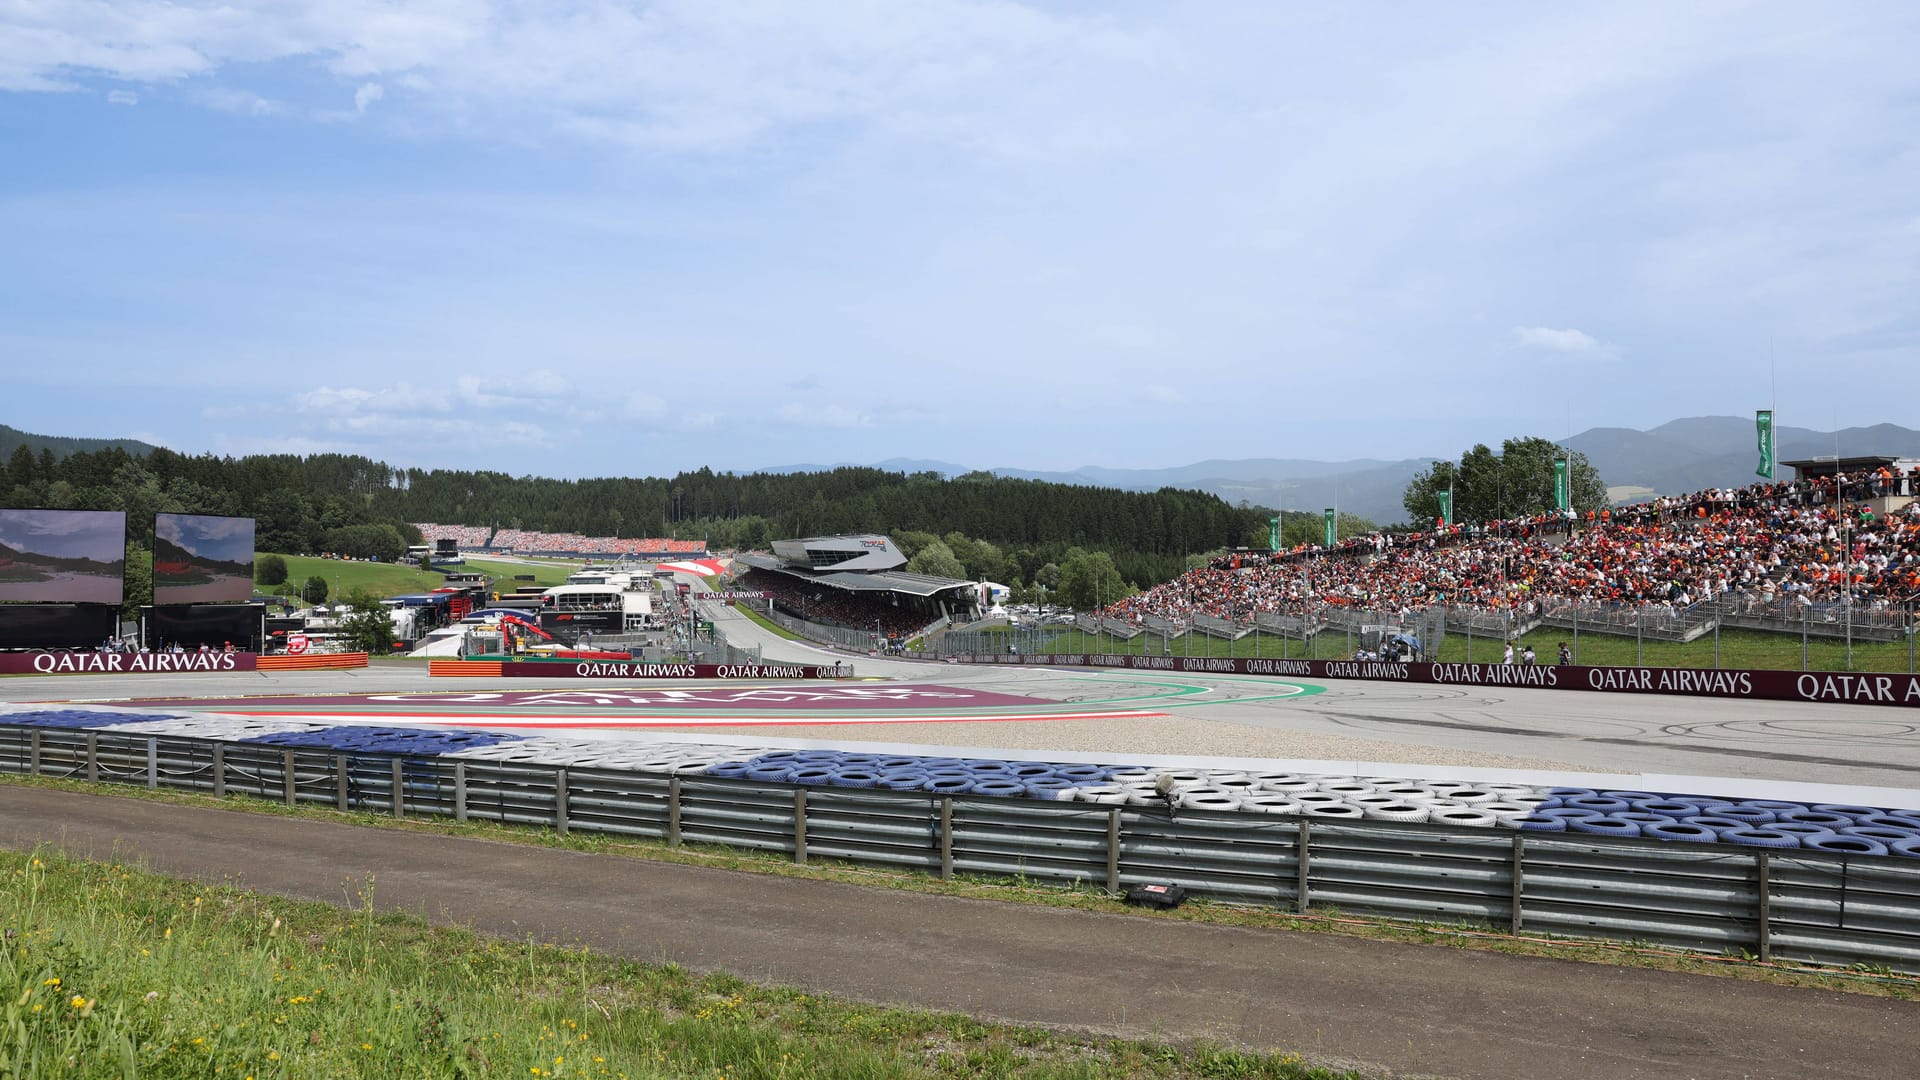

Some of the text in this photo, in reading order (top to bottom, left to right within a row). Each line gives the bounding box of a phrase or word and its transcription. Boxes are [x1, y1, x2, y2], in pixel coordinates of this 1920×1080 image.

[703, 591, 764, 600] QATAR AIRWAYS
[34, 653, 235, 673] QATAR AIRWAYS
[576, 662, 695, 677] QATAR AIRWAYS
[1132, 656, 1174, 669] QATAR AIRWAYS
[1183, 658, 1235, 672] QATAR AIRWAYS
[1246, 659, 1311, 675] QATAR AIRWAYS
[1325, 661, 1408, 679] QATAR AIRWAYS
[717, 664, 804, 678] QATAR AIRWAYS
[816, 666, 837, 678] QATAR
[1431, 663, 1557, 686] QATAR AIRWAYS
[1588, 668, 1752, 694] QATAR AIRWAYS
[1797, 674, 1896, 701] QATAR
[367, 688, 946, 702] QATAR
